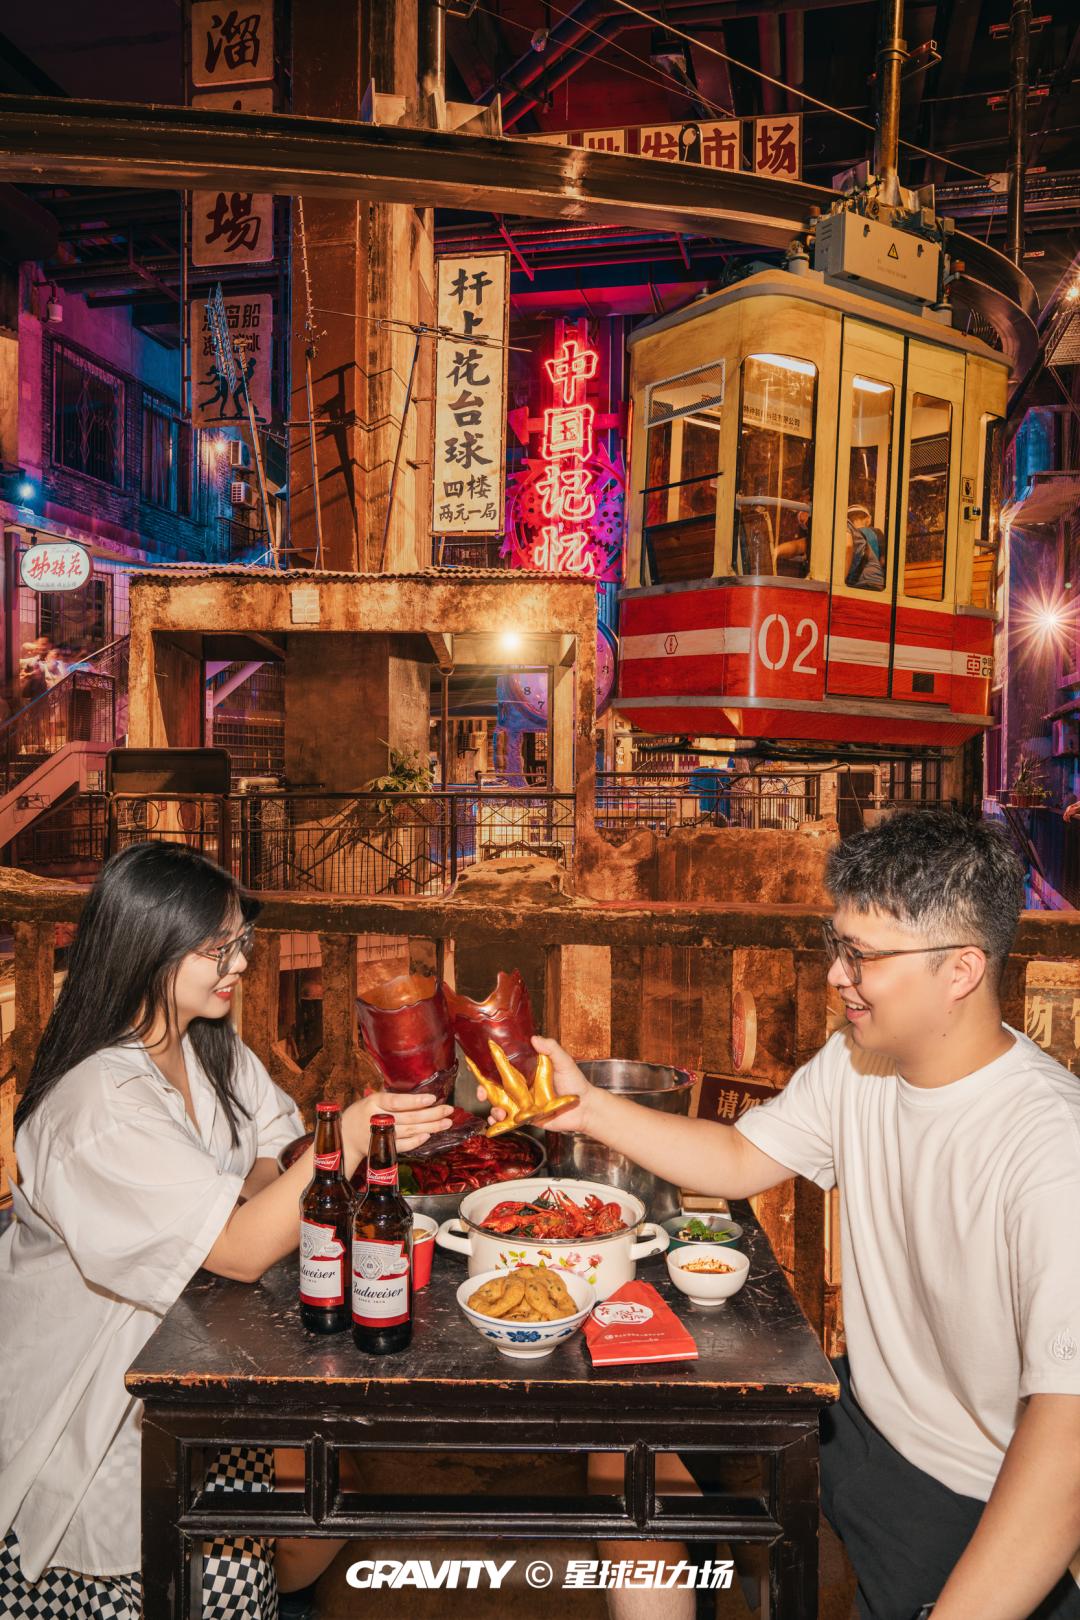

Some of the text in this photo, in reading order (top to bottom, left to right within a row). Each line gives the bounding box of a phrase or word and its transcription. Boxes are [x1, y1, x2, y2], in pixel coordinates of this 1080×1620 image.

[205, 10, 262, 253] 溜場
[443, 474, 492, 500] 四楼
[535, 340, 598, 576] 中国记忆
[439, 502, 497, 523] 两元一局
[758, 613, 819, 675] 02
